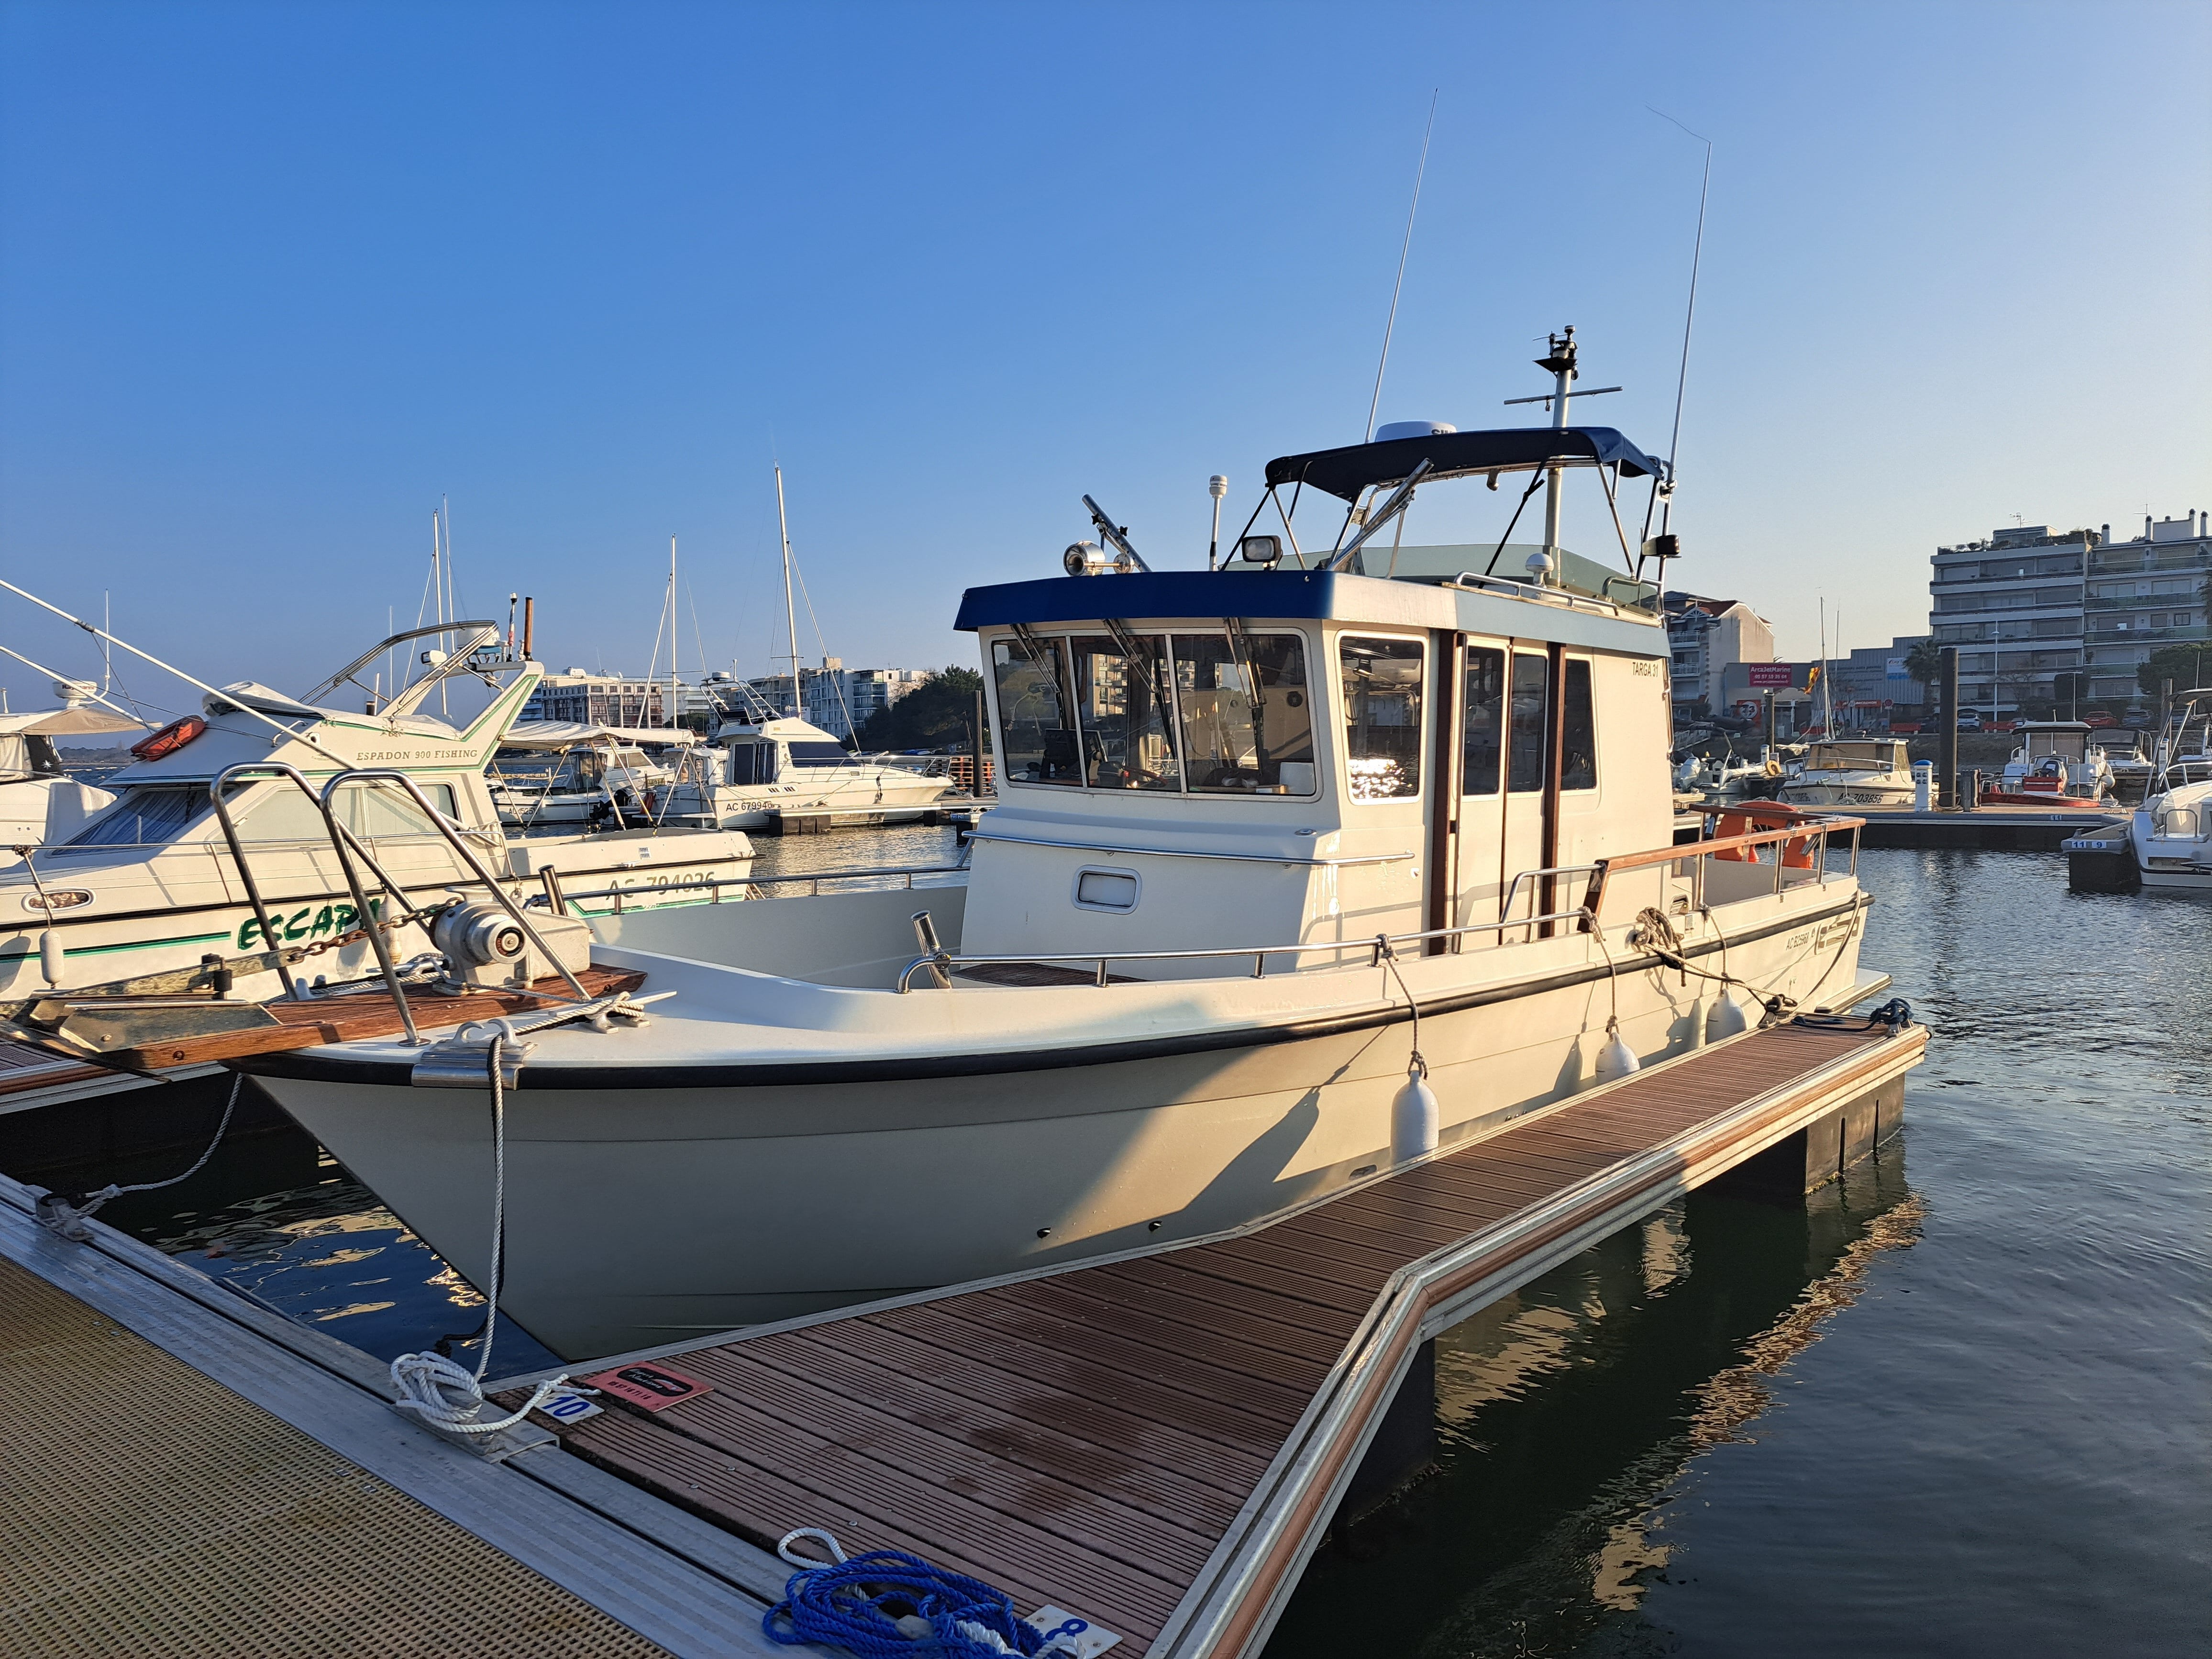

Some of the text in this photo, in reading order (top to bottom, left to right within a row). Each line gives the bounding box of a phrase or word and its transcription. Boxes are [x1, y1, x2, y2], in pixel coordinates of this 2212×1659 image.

[1632, 662, 1659, 677] TARGA 31
[356, 750, 478, 761] ESPADON 900 FISHING
[1853, 793, 1884, 804] 703856
[725, 803, 739, 812] AC
[605, 871, 716, 901] AC 794026
[1785, 937, 1794, 951] AC
[541, 1395, 591, 1417] 10
